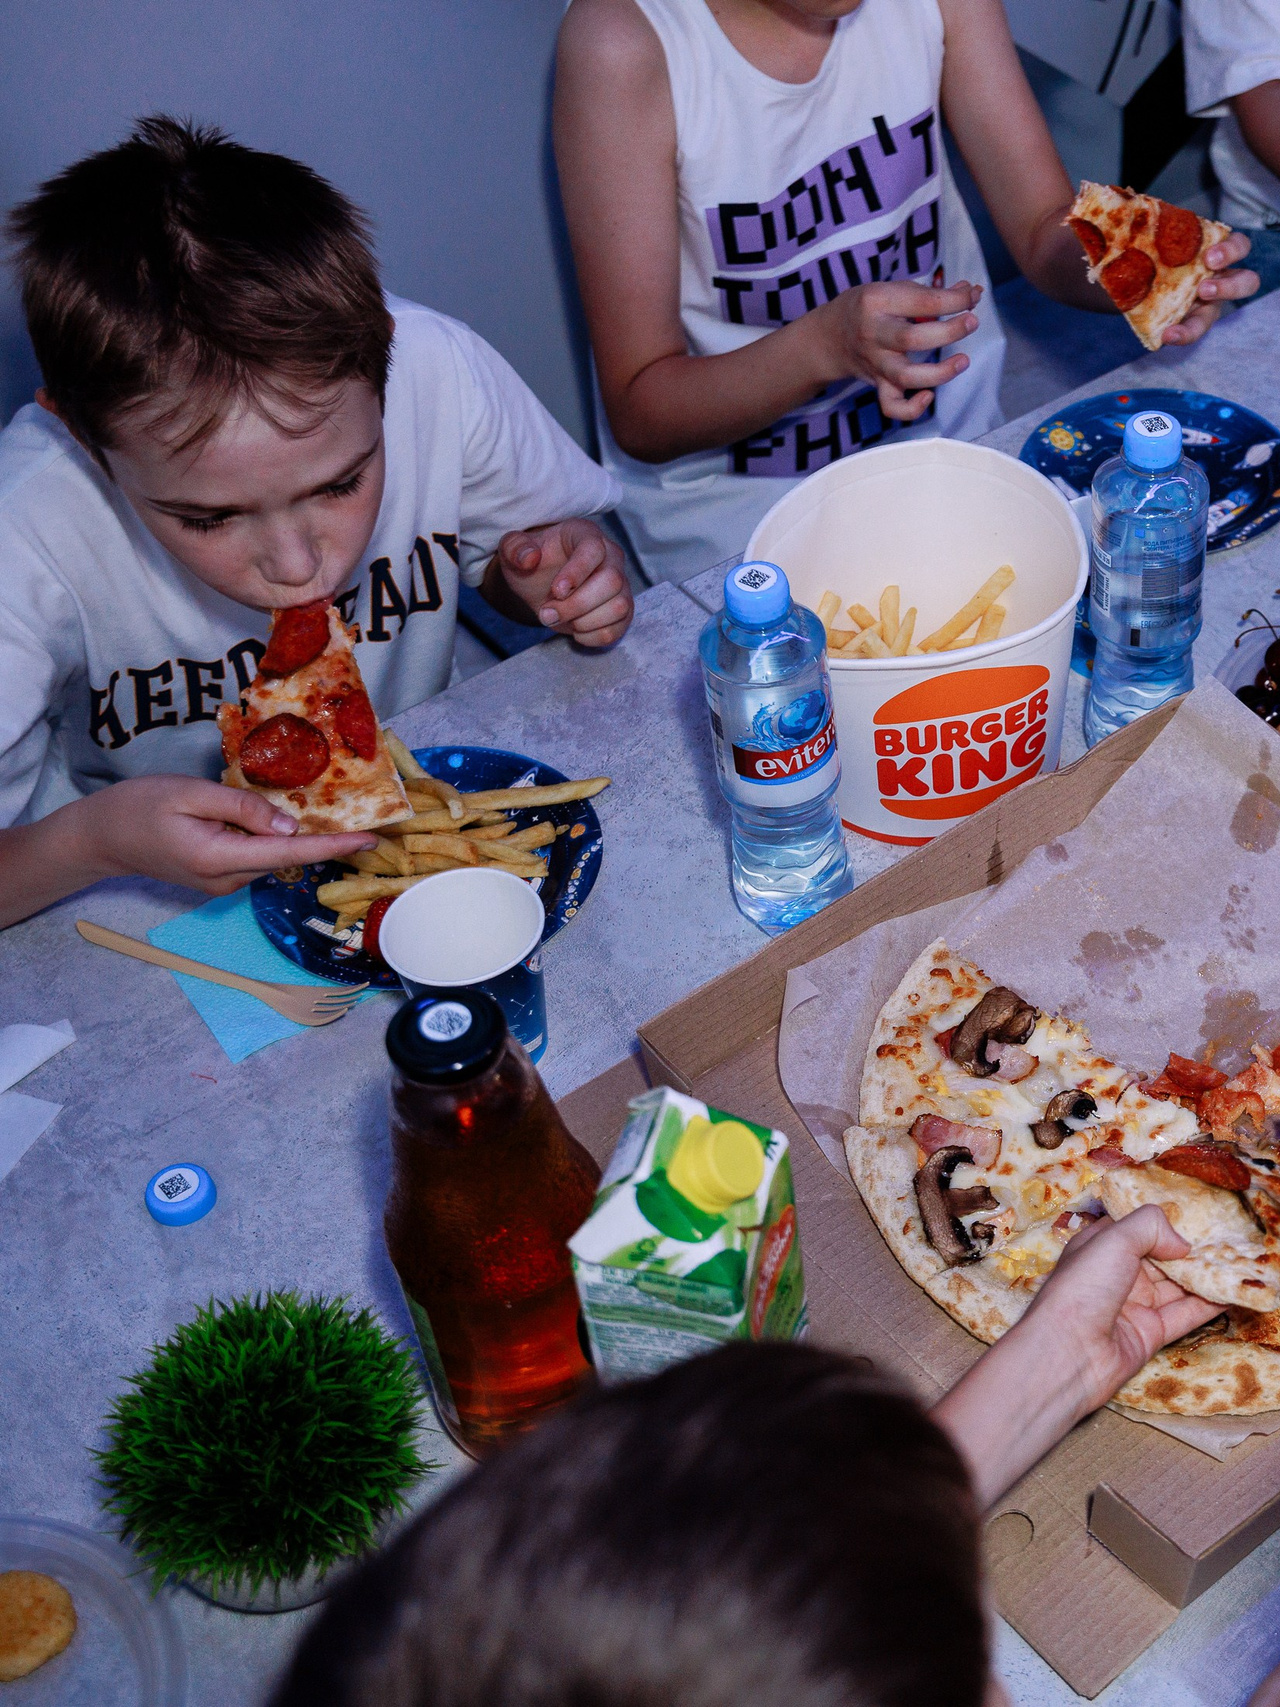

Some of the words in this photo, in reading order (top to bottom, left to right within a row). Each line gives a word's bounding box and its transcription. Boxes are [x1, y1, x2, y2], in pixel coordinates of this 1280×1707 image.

[718, 110, 935, 264] DON'T
[89, 638, 267, 750] KEEP
[874, 688, 1049, 757] BURGER
[876, 718, 1047, 797] KING
